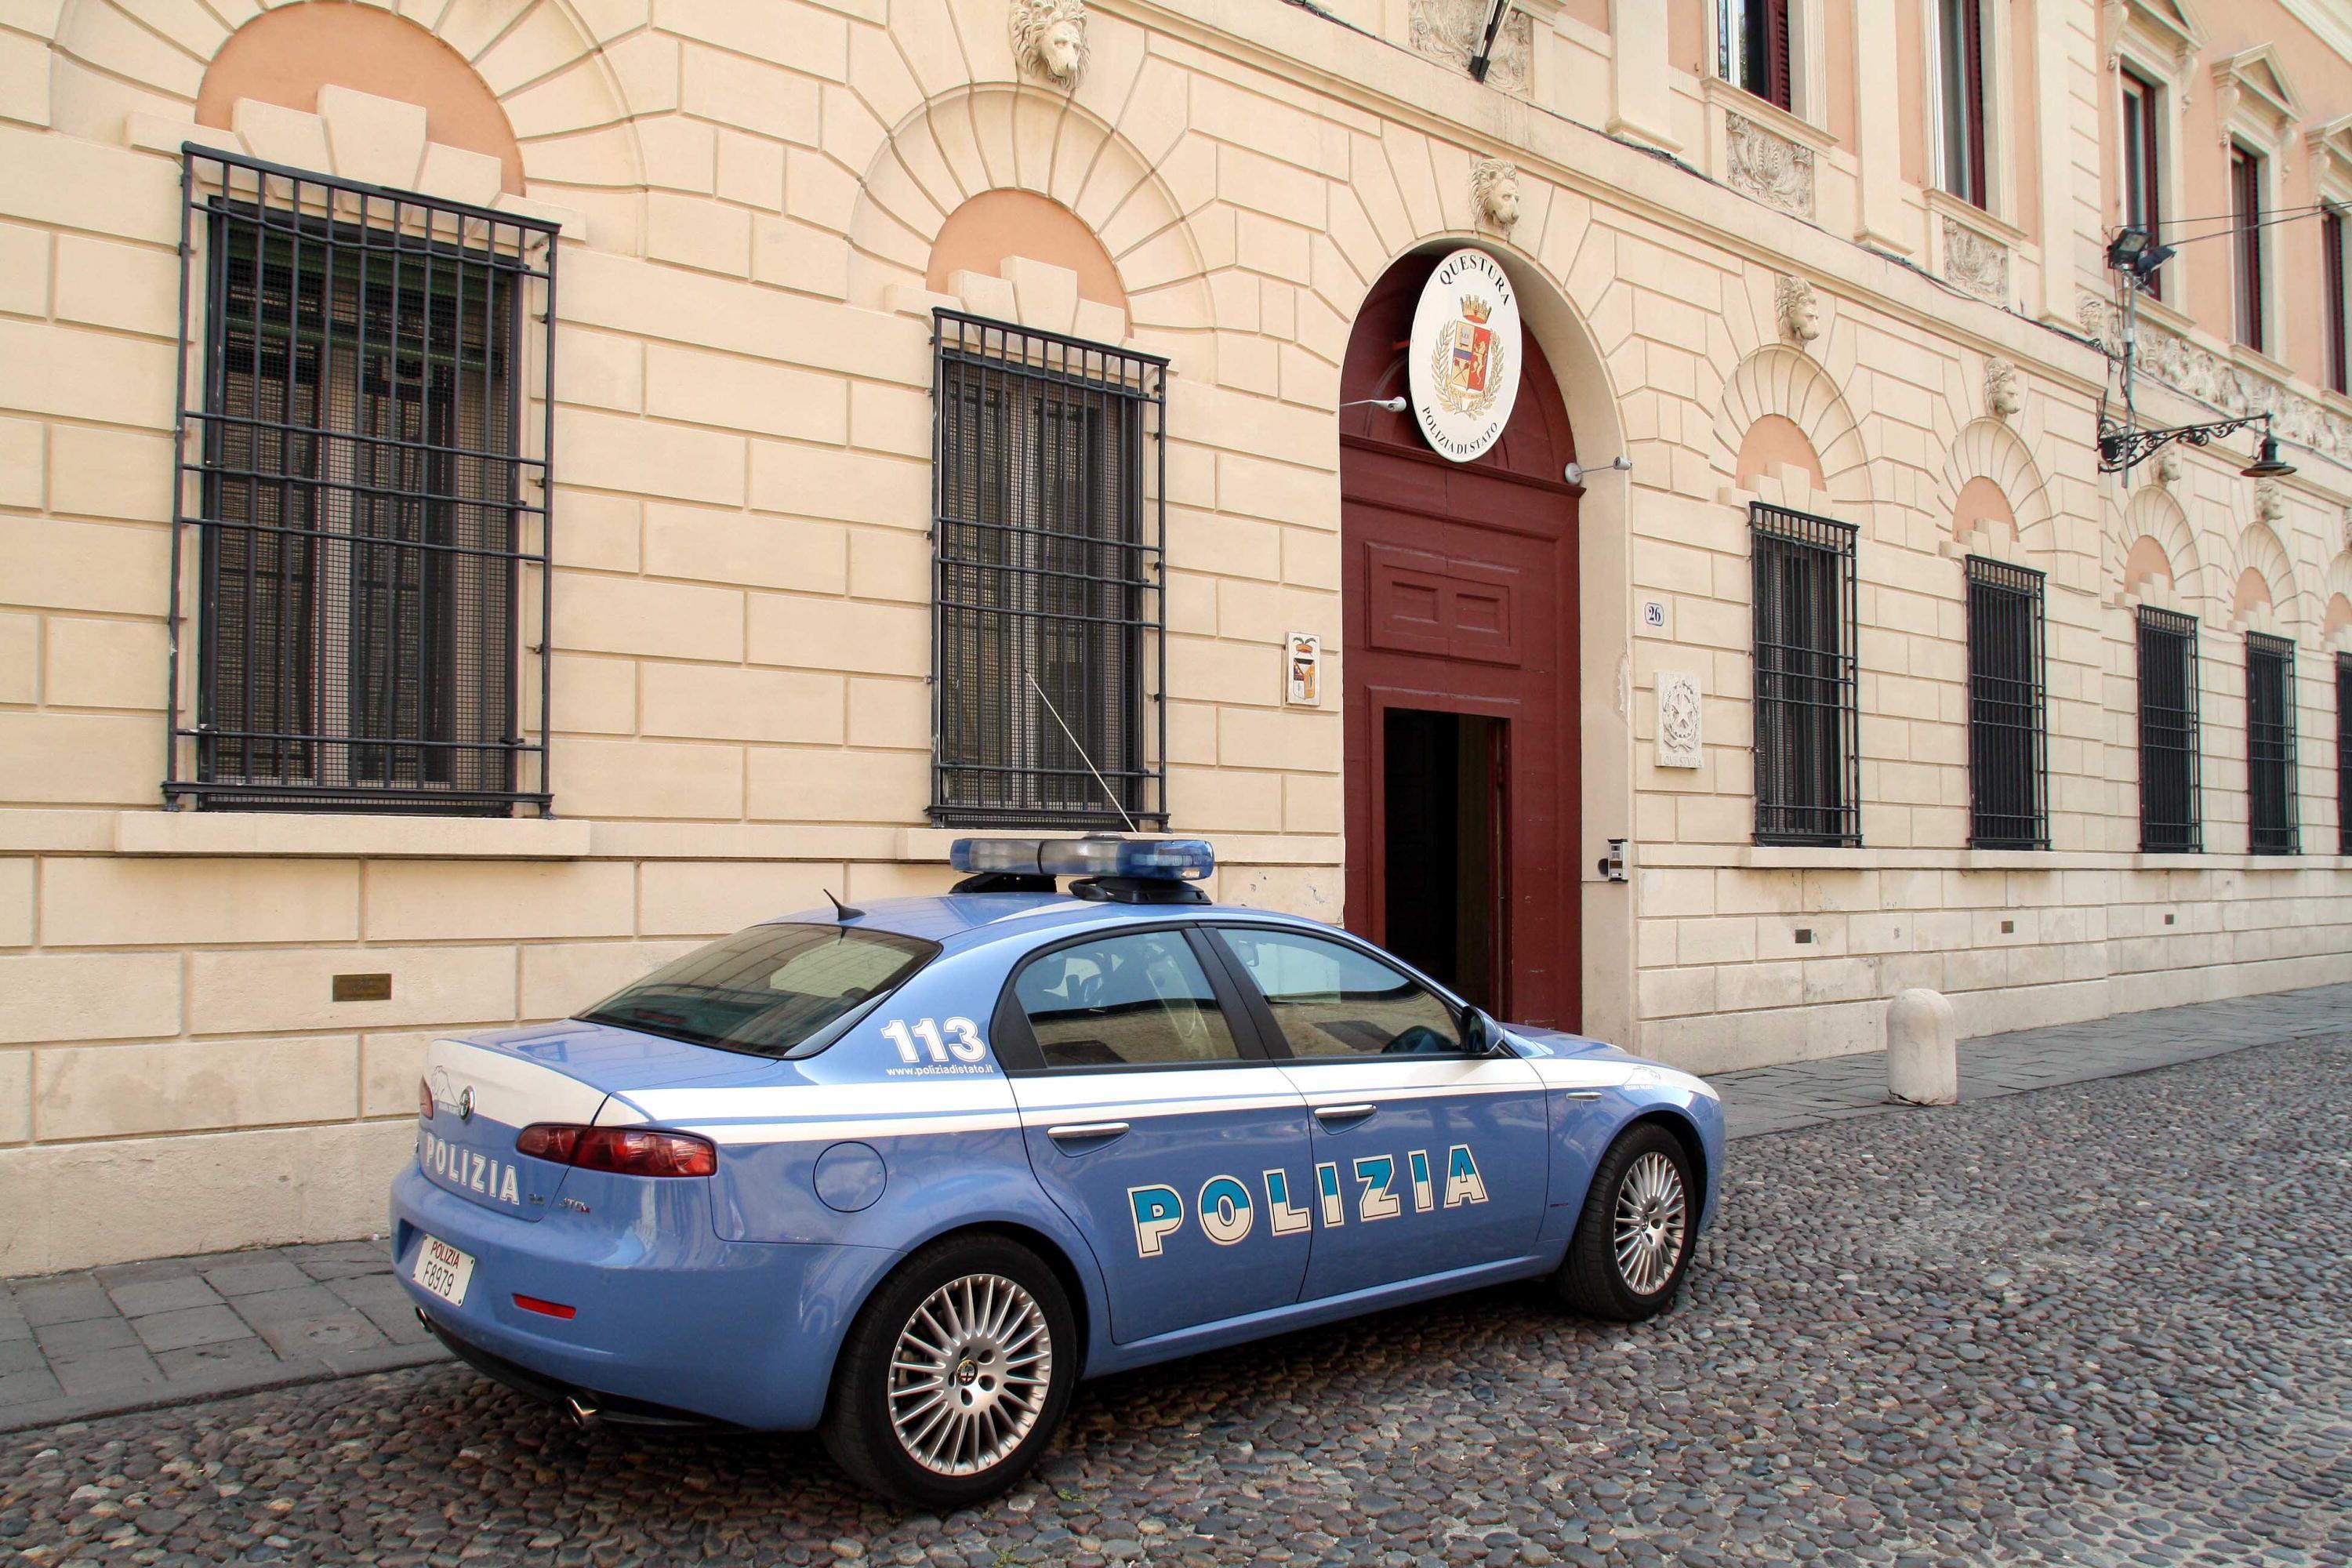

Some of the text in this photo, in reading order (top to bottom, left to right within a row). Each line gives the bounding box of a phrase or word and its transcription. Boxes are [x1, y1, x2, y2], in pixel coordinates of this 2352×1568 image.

[1440, 254, 1510, 307] QUESTURA
[1422, 406, 1497, 454] POLIZIA DI STATO
[1648, 606, 1661, 622] 26
[880, 1016, 986, 1063] 113
[886, 1064, 994, 1076] www.poliziadistato.it
[426, 1132, 520, 1205] POLIZIA
[1127, 1143, 1489, 1258] POLIZIA
[430, 1241, 460, 1269] POLIZIA
[423, 1261, 454, 1297] F8979
